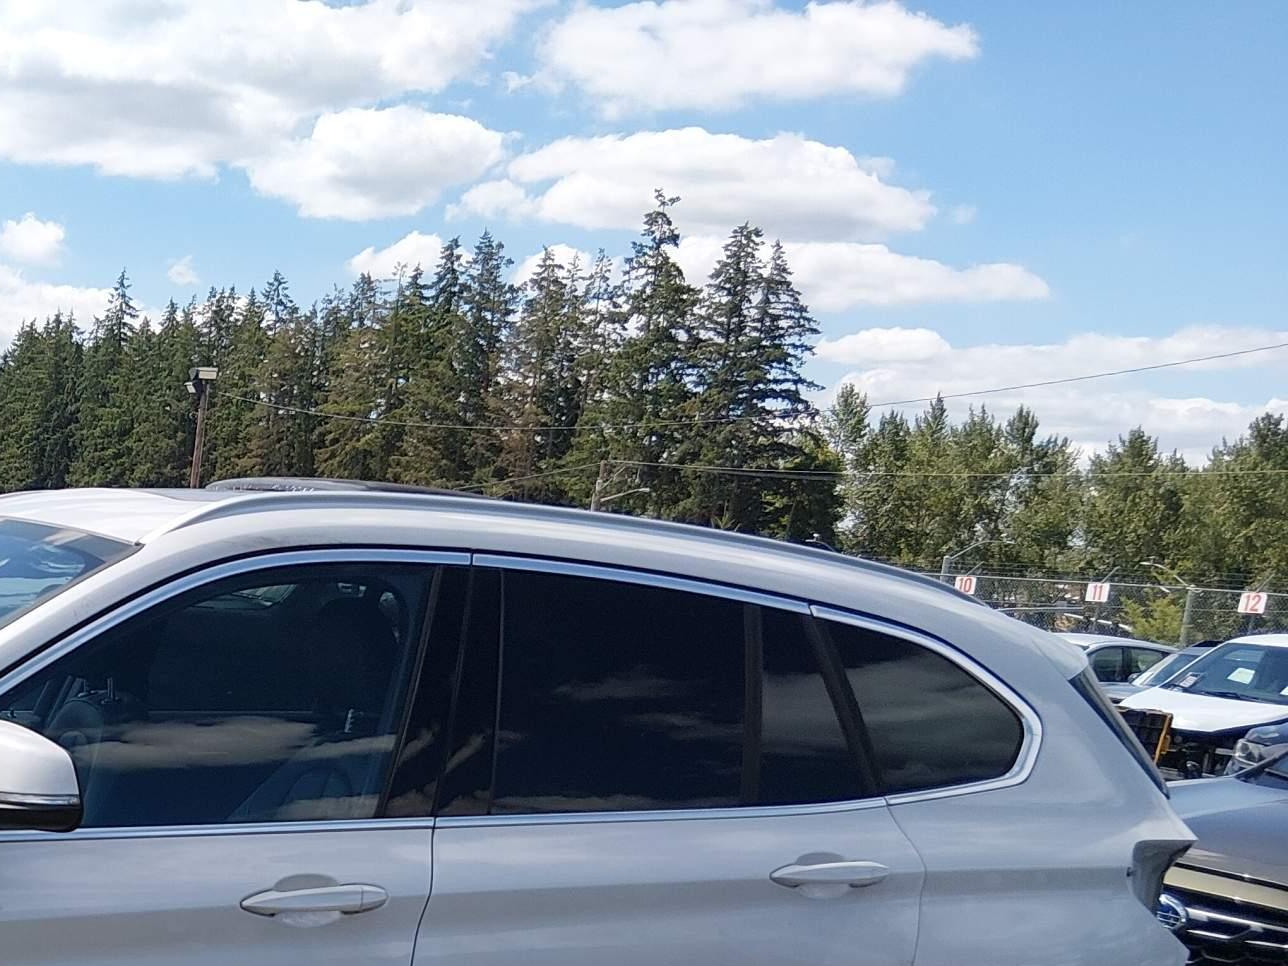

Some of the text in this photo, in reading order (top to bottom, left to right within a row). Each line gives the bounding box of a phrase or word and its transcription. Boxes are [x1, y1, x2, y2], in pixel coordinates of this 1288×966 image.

[957, 578, 972, 593] 10
[1092, 584, 1103, 601] 11
[1244, 594, 1262, 612] 12
